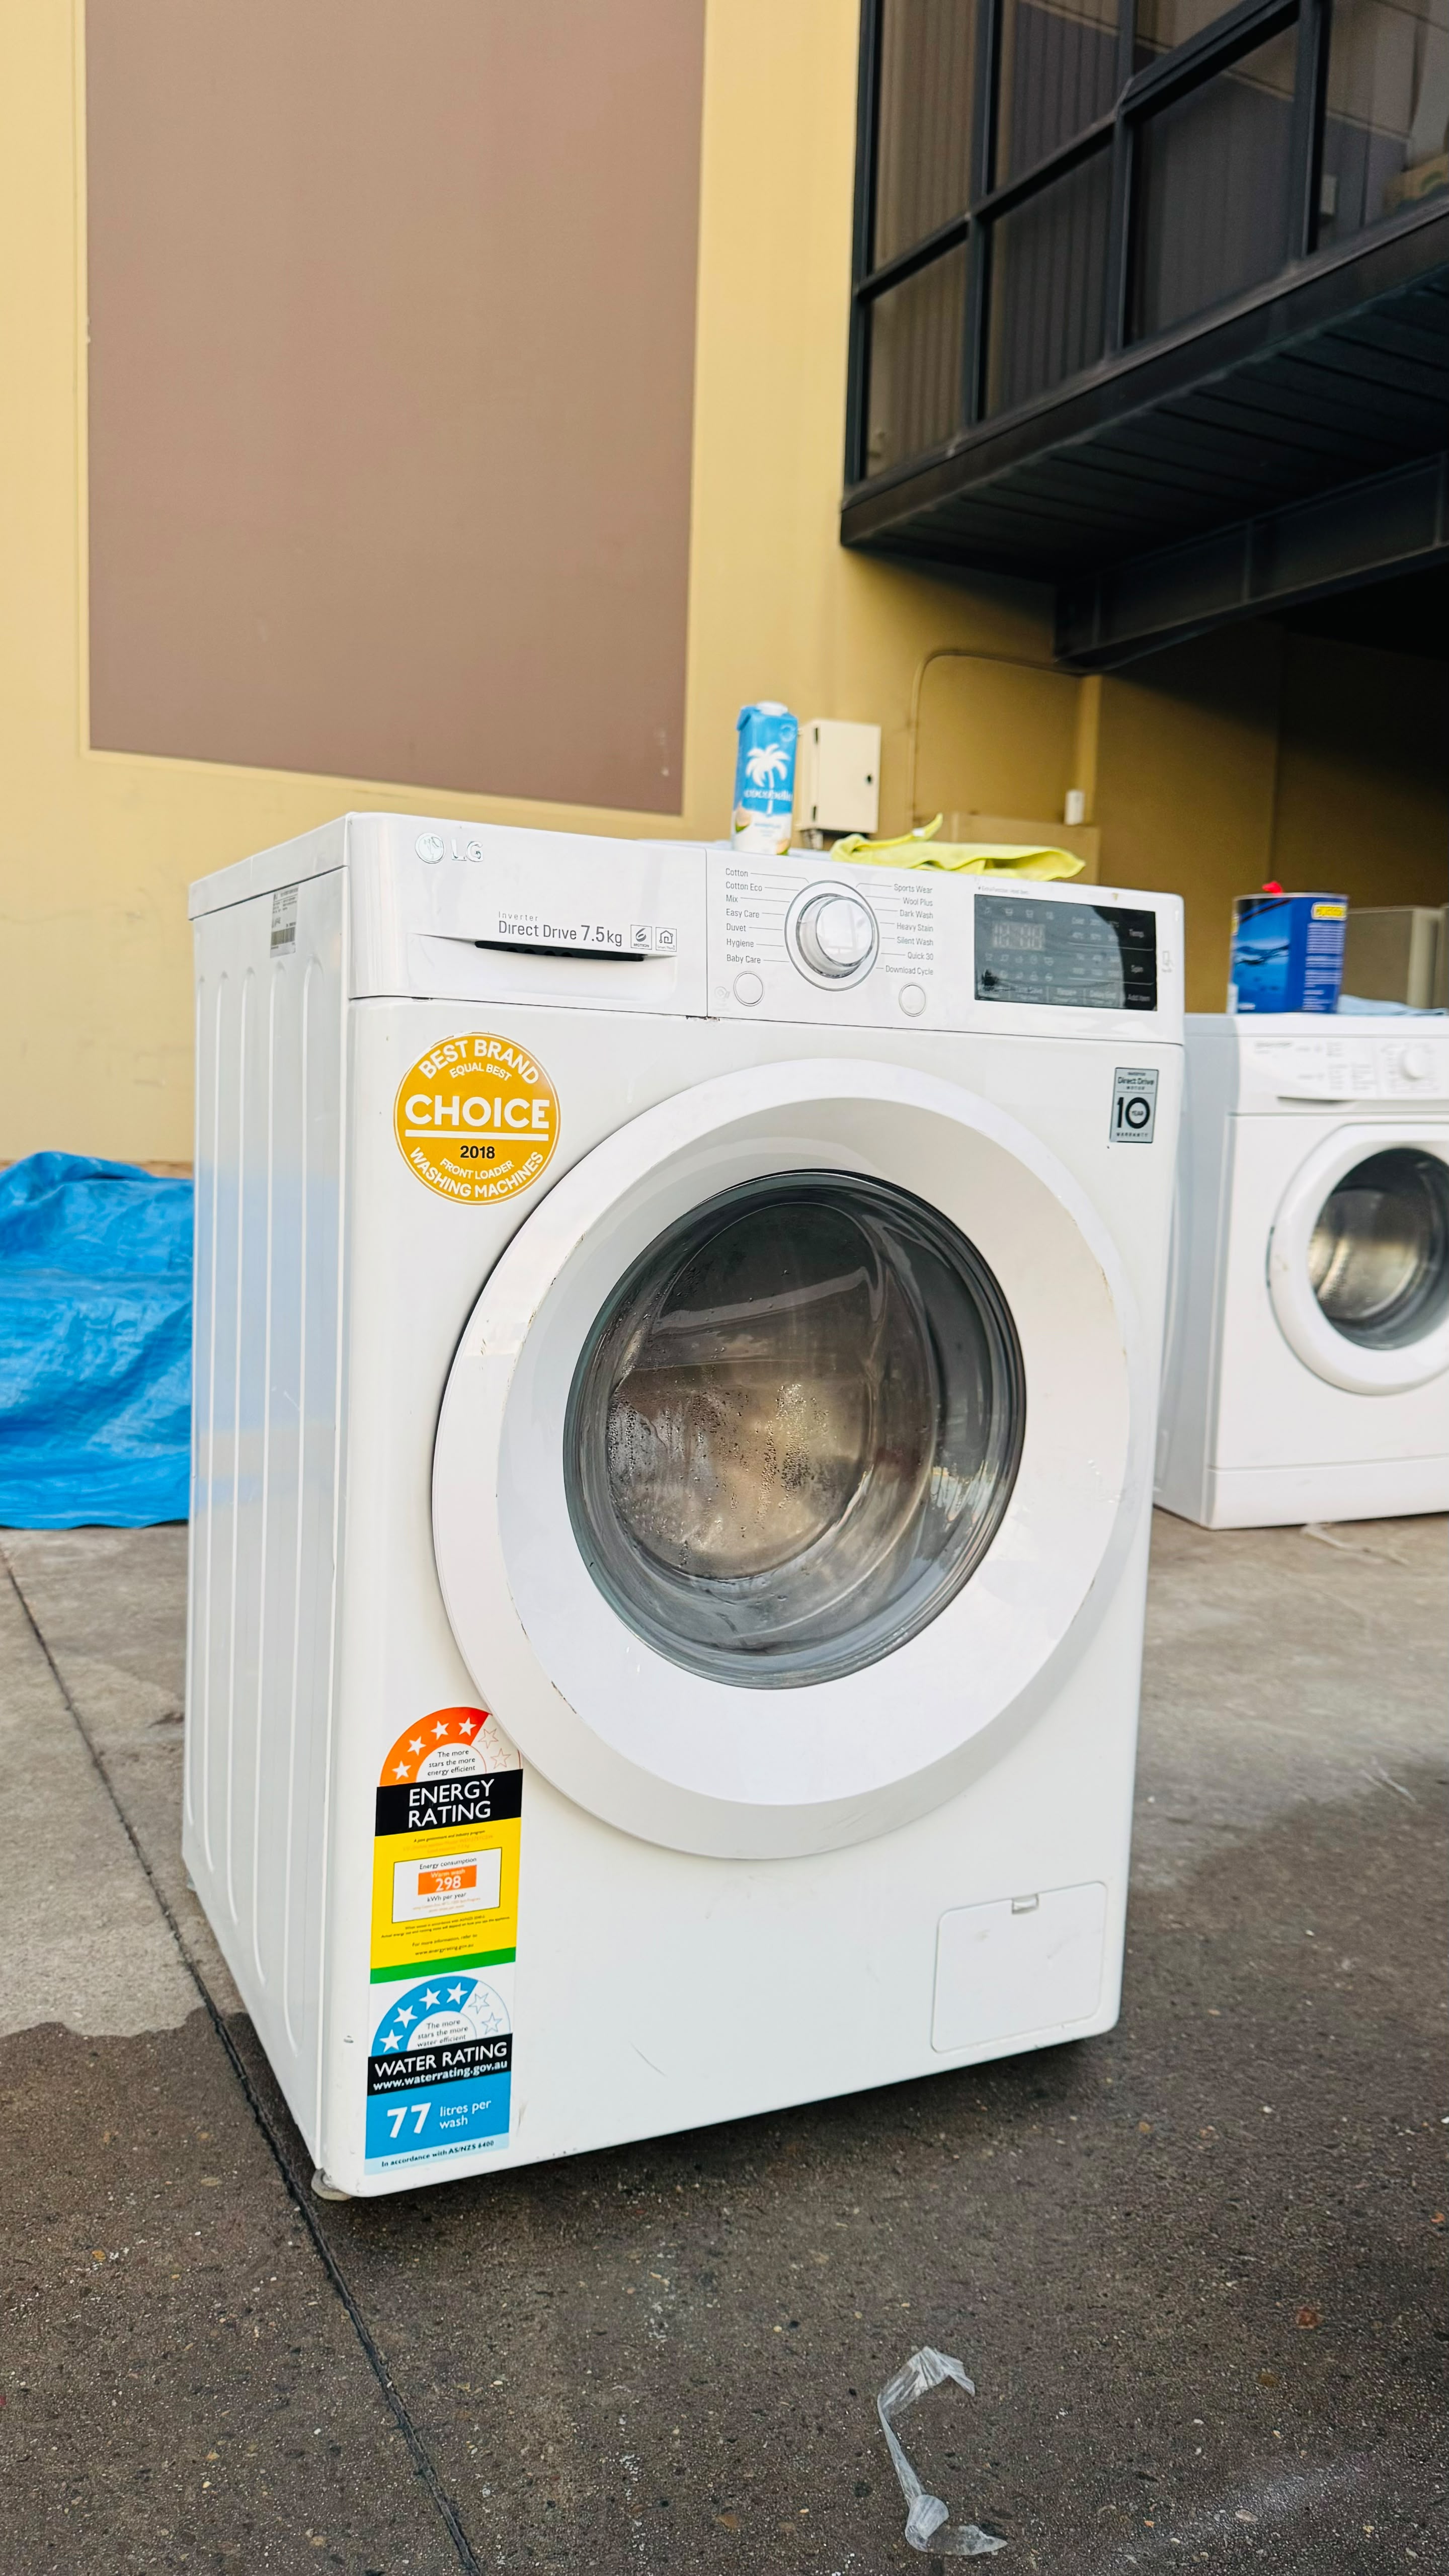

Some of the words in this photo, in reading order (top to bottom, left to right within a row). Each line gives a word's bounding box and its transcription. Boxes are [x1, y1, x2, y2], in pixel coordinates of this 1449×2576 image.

[451, 838, 484, 862] LG
[726, 868, 748, 877] Cotton
[726, 882, 748, 891] Cotton
[894, 883, 915, 894] Sports
[917, 886, 932, 894] Wear
[726, 895, 738, 903] Mix
[903, 897, 918, 905] Wool
[499, 911, 538, 921] Inverter
[726, 909, 742, 919] Easy
[744, 910, 760, 918] Care
[900, 910, 913, 918] Dark
[915, 911, 933, 919] Wash
[499, 920, 539, 937] Direct
[543, 924, 577, 940] Drive
[726, 923, 747, 932] Duvet
[897, 923, 915, 932] Heavy
[917, 924, 933, 932] Stain
[727, 939, 754, 948] Hygiene
[897, 936, 914, 945] Silent
[915, 938, 933, 946] Wash
[727, 954, 745, 964] Baby
[908, 952, 924, 960] Quick
[886, 965, 916, 975] Download
[918, 967, 933, 976] Cycle
[418, 1039, 468, 1079] BEST
[474, 1039, 539, 1084] BRAND
[449, 1062, 484, 1078] EQUAL
[486, 1063, 512, 1081] BEST
[405, 1094, 550, 1129] CHOICE
[1117, 1097, 1150, 1129] 10
[460, 1146, 495, 1159] 2018
[410, 1147, 471, 1197] WASHING
[474, 1152, 543, 1198] MACHINES
[440, 1158, 473, 1179] FRONT
[475, 1160, 514, 1180] LOADER
[409, 1779, 495, 1807] ENERGY
[408, 1801, 491, 1828] RATING
[441, 1858, 476, 1867] consumption
[436, 1875, 461, 1892] 298
[439, 2035, 466, 2044] efficient
[374, 2053, 437, 2077] WATER
[442, 2042, 507, 2069] RATING
[373, 2060, 508, 2091] www.waterrating.gov.au
[440, 2105, 468, 2117] litres
[471, 2099, 492, 2114] per
[386, 2102, 432, 2139] 77
[439, 2115, 468, 2130] wash
[390, 2153, 430, 2165] accordance
[448, 2143, 476, 2154] AS/NZS
[478, 2140, 494, 2148] 6400
